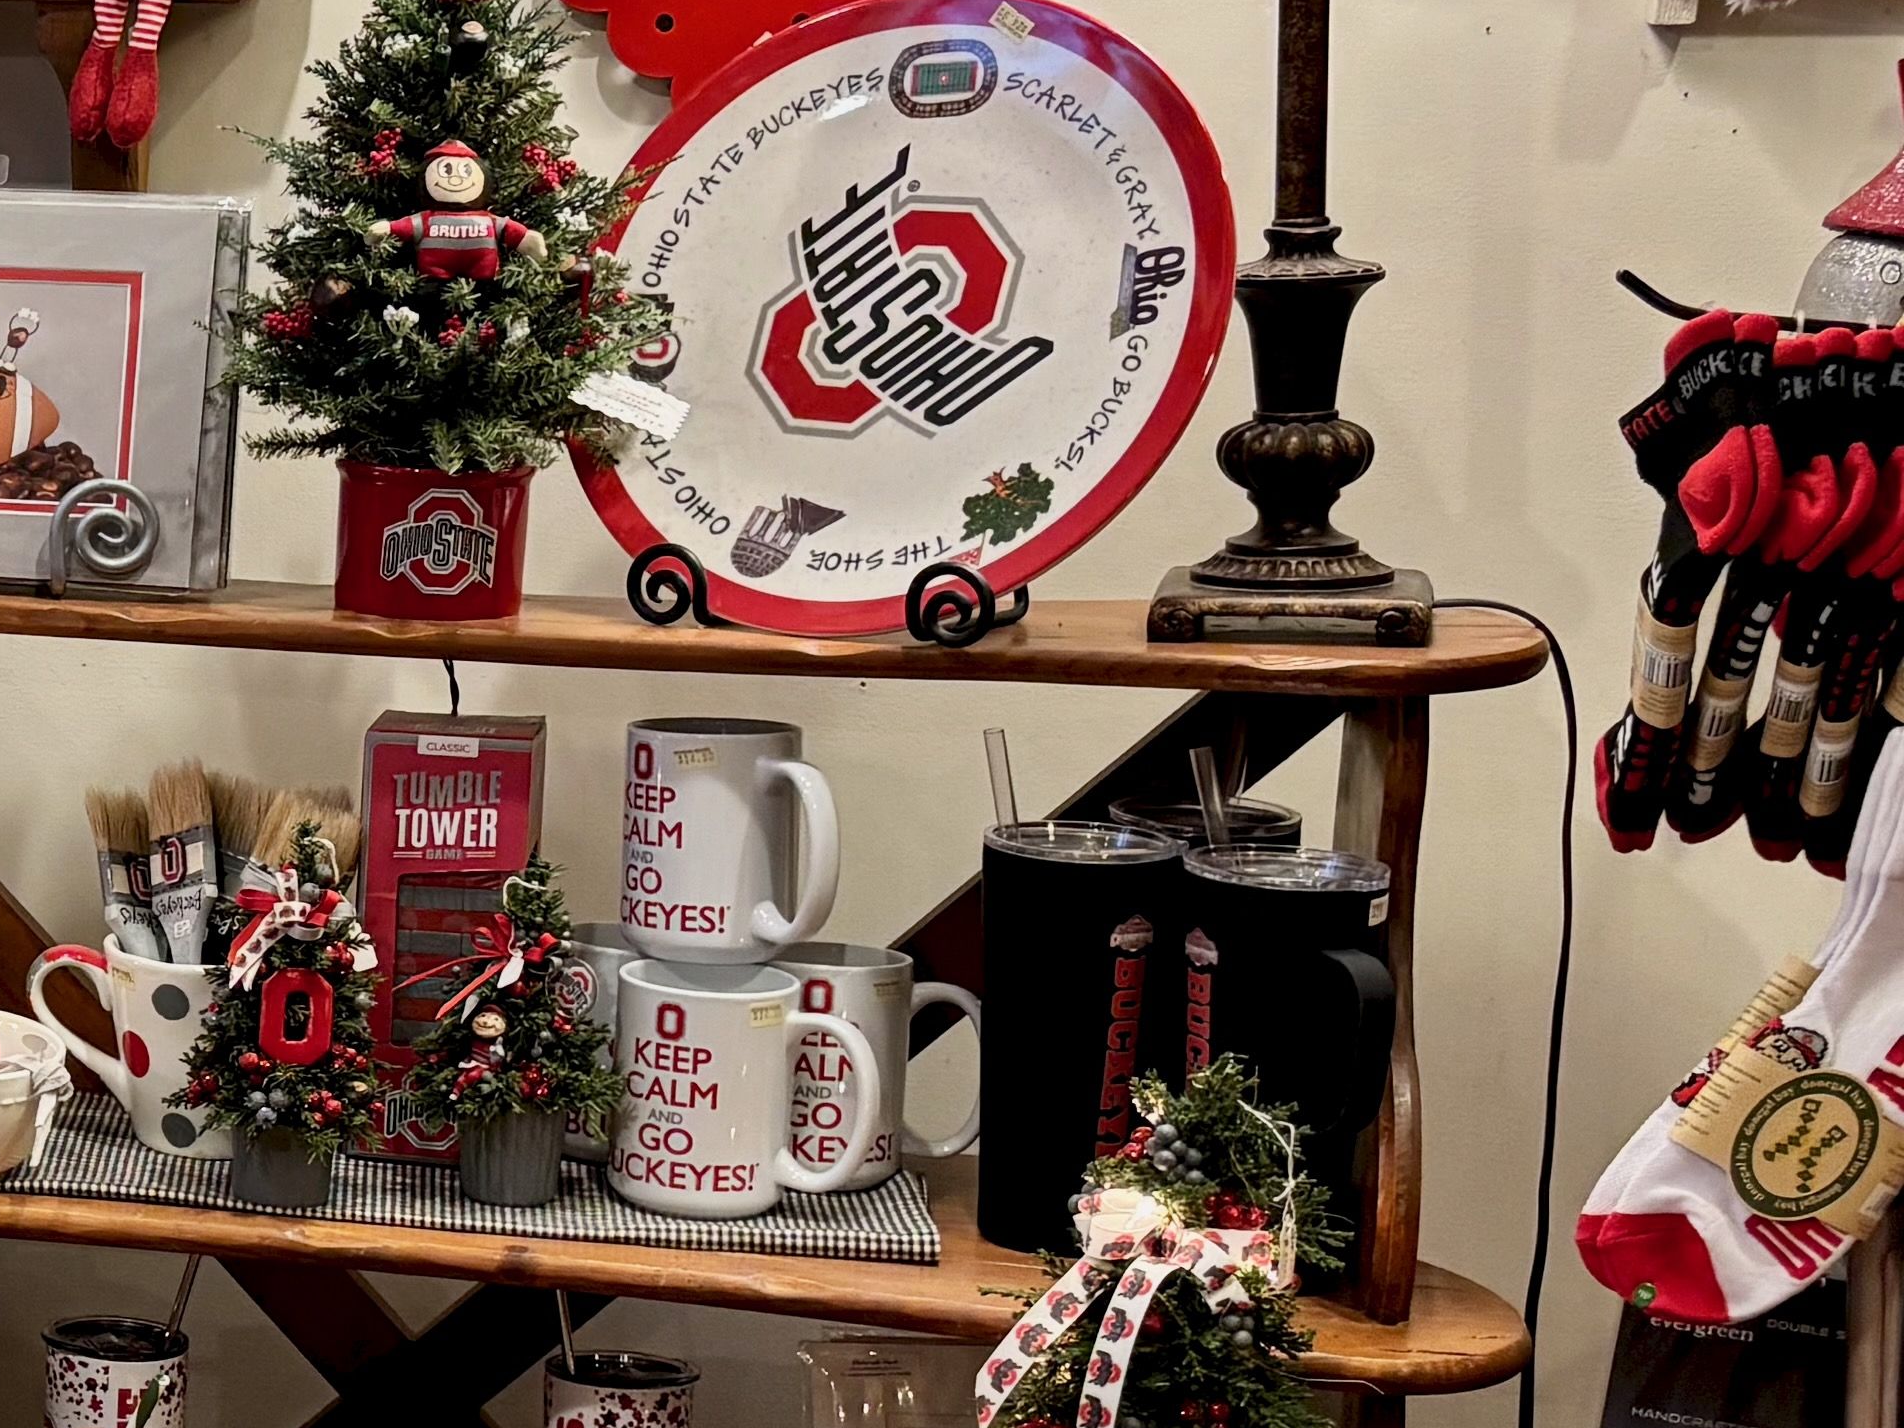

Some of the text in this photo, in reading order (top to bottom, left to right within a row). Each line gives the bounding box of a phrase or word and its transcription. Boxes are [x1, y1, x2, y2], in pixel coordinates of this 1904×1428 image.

[1003, 71, 1113, 150] SCARLET
[644, 68, 886, 290] OHIO STATE BUCKEYES
[427, 221, 490, 240] BRUTUS
[1053, 336, 1148, 474] GO BUCKS!
[673, 486, 731, 537] OHIO
[891, 534, 954, 568] THE
[425, 741, 472, 755] CLASSIC
[392, 770, 502, 807] TUMBLE
[394, 808, 499, 849] TOWER
[626, 866, 662, 896] GO
[633, 1038, 713, 1075] KEEP
[626, 1074, 719, 1111] CALM
[647, 1108, 684, 1126] AND
[637, 1121, 694, 1156] GO
